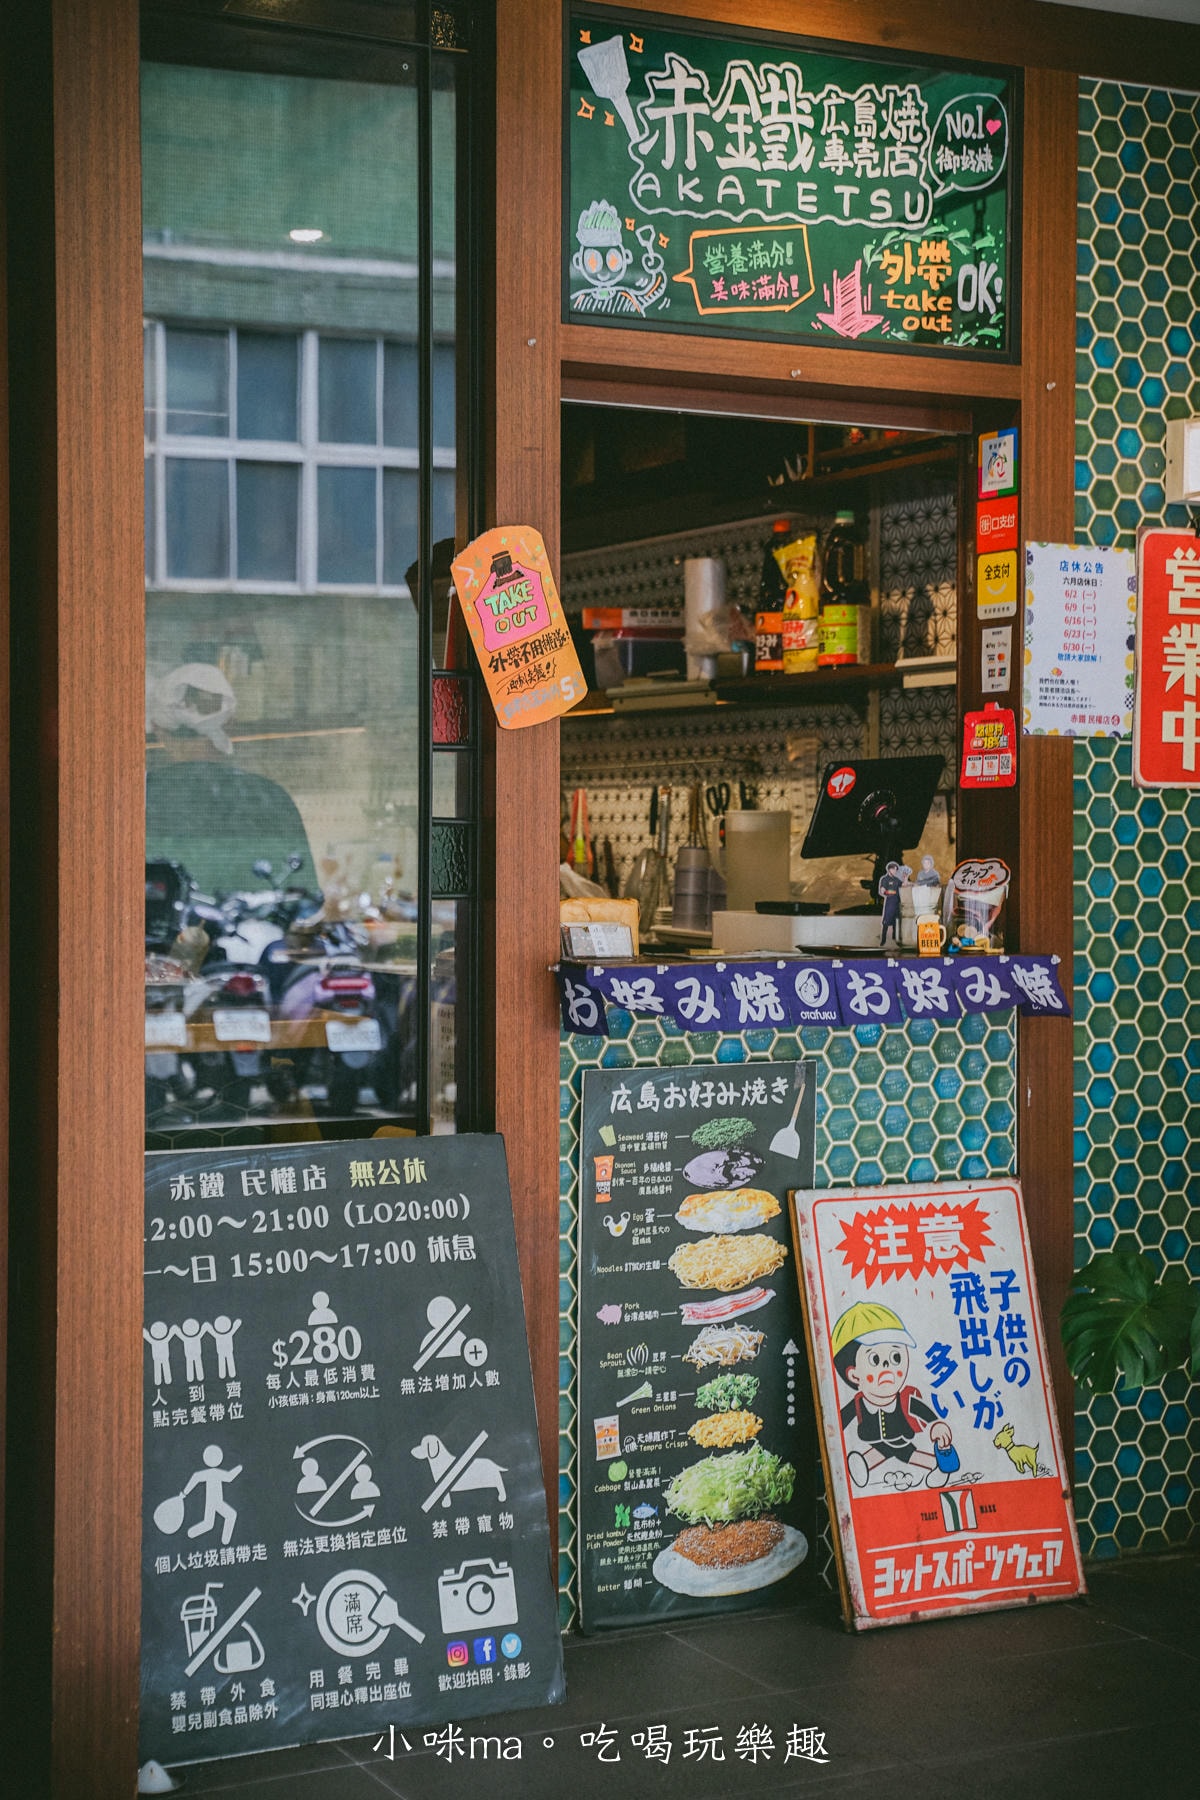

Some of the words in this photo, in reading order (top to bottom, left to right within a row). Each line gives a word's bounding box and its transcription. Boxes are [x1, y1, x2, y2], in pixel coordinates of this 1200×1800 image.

[639, 64, 815, 173] 赤鐵
[820, 91, 924, 143] 広島焼
[637, 172, 924, 222] AKATETSU
[880, 239, 953, 290] 外帶
[880, 291, 953, 312] take
[902, 313, 953, 333] out
[984, 563, 1010, 581] 全支付
[1059, 560, 1104, 575] 店休公告
[483, 579, 535, 617] TAKE
[1065, 590, 1077, 599] 6/2
[1065, 603, 1077, 612] 6/9
[495, 605, 538, 634] OUT
[1064, 616, 1081, 625] 6/16
[1063, 630, 1080, 639] 6/23
[1063, 643, 1080, 652] 6/30
[921, 939, 939, 948] BEER
[565, 971, 785, 1028] お好み焼
[847, 963, 1064, 1017] お好み焼
[610, 1076, 789, 1114] 広島お好み焼き
[241, 1164, 327, 1197] 民權店
[349, 1157, 428, 1188] 無公休
[144, 1204, 330, 1242] 2:00~21:00
[427, 1234, 477, 1263] 休息
[863, 1213, 970, 1268] 注意
[597, 1265, 623, 1273] Noodles
[624, 1302, 640, 1310] Pork
[988, 1270, 1031, 1388] 子供の
[272, 1324, 362, 1369] $280
[607, 1352, 623, 1360] Bean
[949, 1271, 1004, 1431] 飛出しが
[266, 1364, 376, 1391] 每人最低消費
[600, 1360, 626, 1369] Sprouts
[400, 1369, 501, 1396] 無法增加人數
[925, 1341, 966, 1419] 多い
[151, 1402, 245, 1428] 點完餐帶位
[631, 1407, 650, 1415] Green
[653, 1403, 676, 1412] Onions
[665, 1440, 688, 1449] Crisps
[594, 1484, 621, 1492] Cabbage
[432, 1512, 515, 1538] 禁帶寵物
[586, 1532, 604, 1541] Dried
[283, 1527, 408, 1558] 無法更換指定座位
[587, 1542, 601, 1550] Fish
[603, 1540, 624, 1548] Powder
[154, 1543, 268, 1575] 個人垃圾請帶走
[873, 1537, 1065, 1598] ヨットスポーツウェア
[597, 1584, 621, 1592] Batter
[343, 1592, 364, 1635] 滿席
[309, 1657, 410, 1689] 用餐完畢
[170, 1678, 277, 1710] 禁帶外食
[310, 1681, 412, 1711] 同理心釋出座位
[171, 1702, 279, 1735] 嬰兒副食品除外
